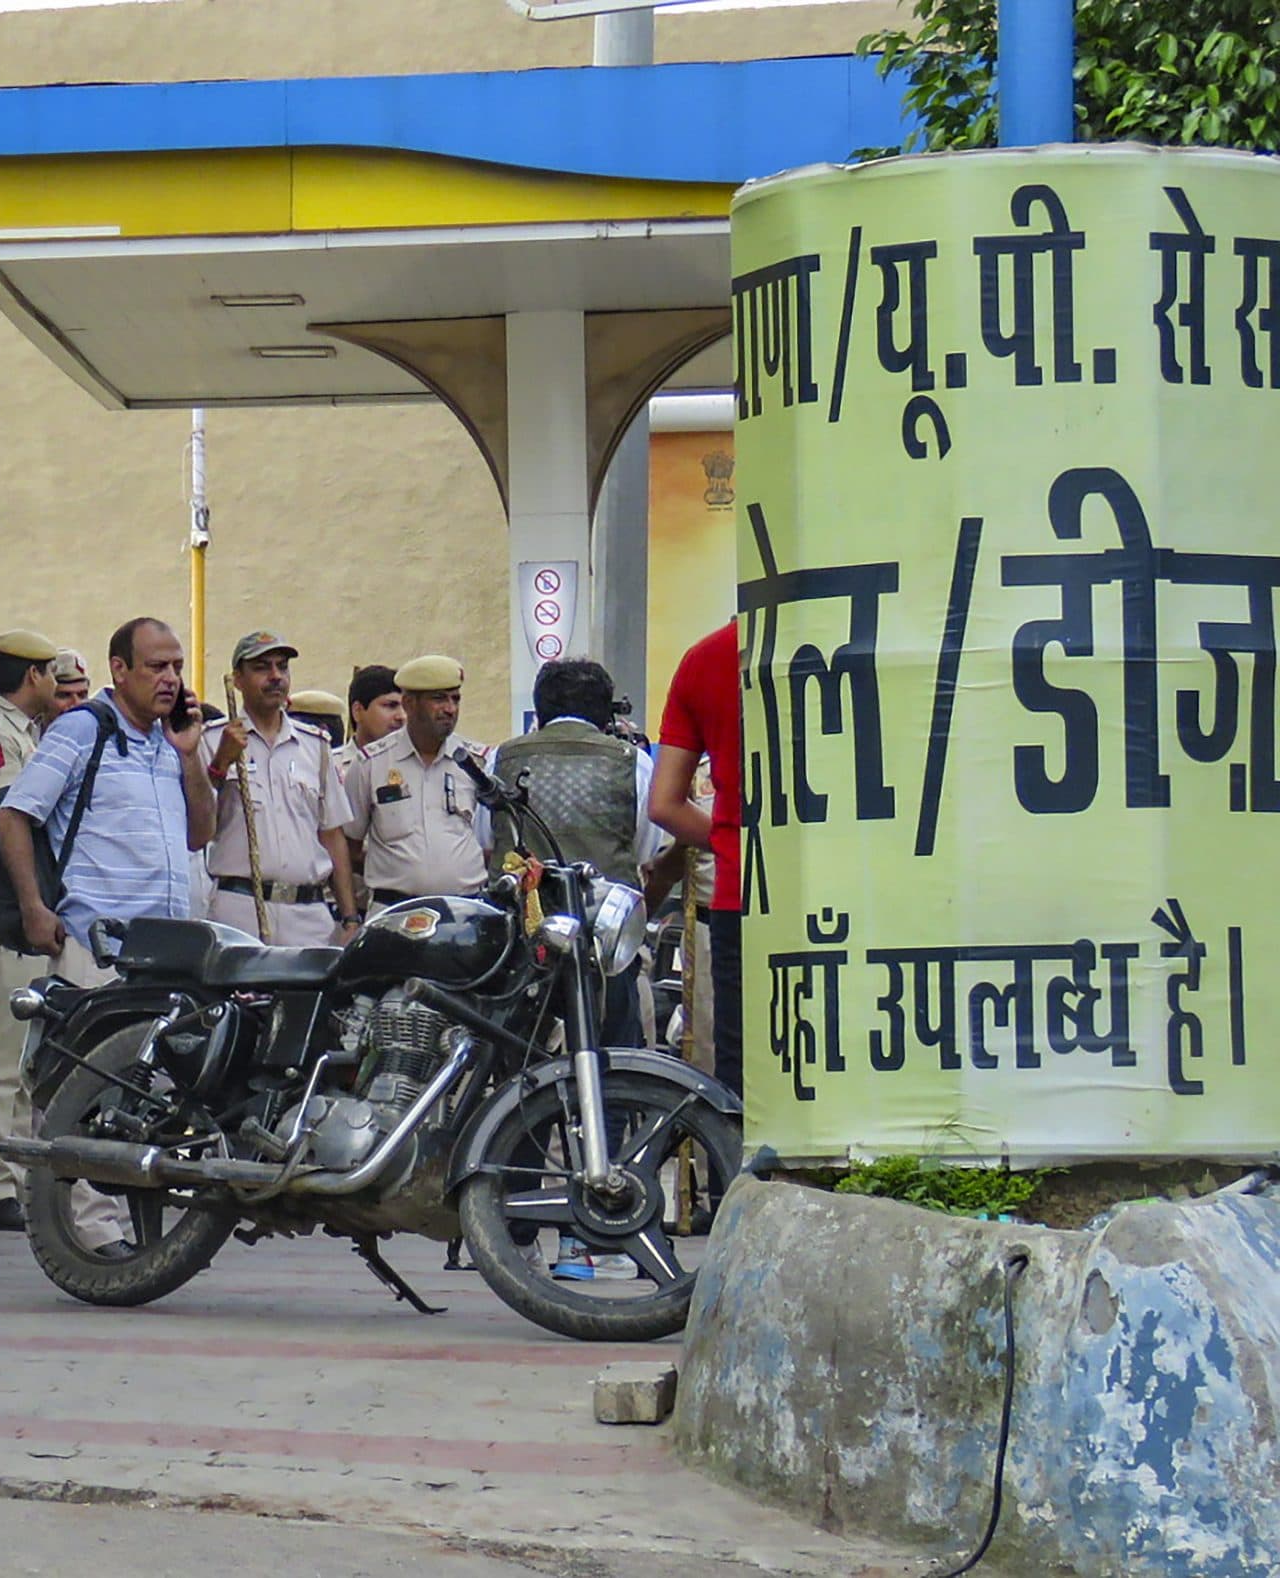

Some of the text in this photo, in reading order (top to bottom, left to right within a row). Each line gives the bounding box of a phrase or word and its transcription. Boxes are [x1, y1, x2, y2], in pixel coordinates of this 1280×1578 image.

[731, 184, 1117, 460] ाणा/यू.पी.
[1149, 186, 1216, 385] से
[768, 907, 849, 1101] यहाँ
[866, 938, 1140, 1072] उपलब्ध
